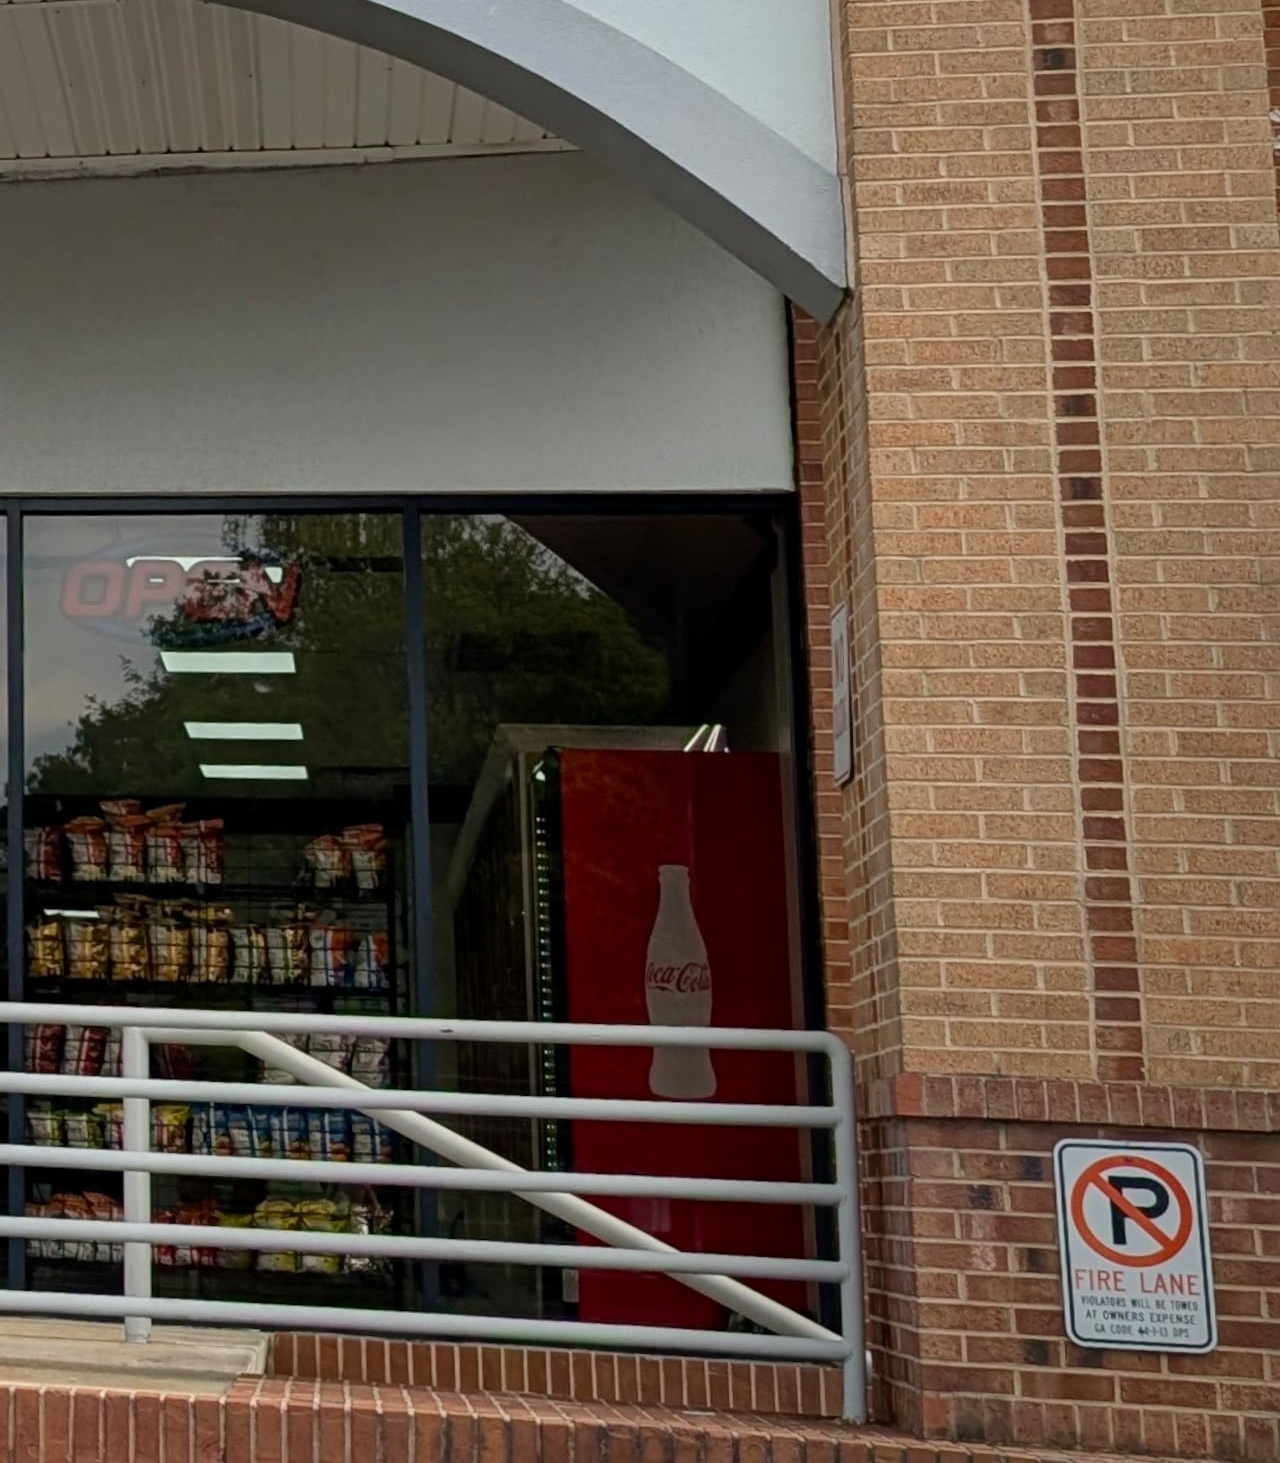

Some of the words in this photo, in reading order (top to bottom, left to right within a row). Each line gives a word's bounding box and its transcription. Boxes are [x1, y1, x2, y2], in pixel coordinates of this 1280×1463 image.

[61, 558, 302, 622] OPEN
[1074, 1268, 1126, 1293] FIRE
[1139, 1272, 1201, 1296] LANE
[1080, 1295, 1127, 1308] VIOLATORS
[1130, 1298, 1151, 1309] WILL
[1155, 1300, 1166, 1310] BE
[1170, 1300, 1198, 1312] TOWED
[1085, 1309, 1097, 1319] AT
[1102, 1310, 1145, 1322] OWNERS
[1149, 1312, 1197, 1325] EXPENSE
[1110, 1324, 1133, 1335] CODE
